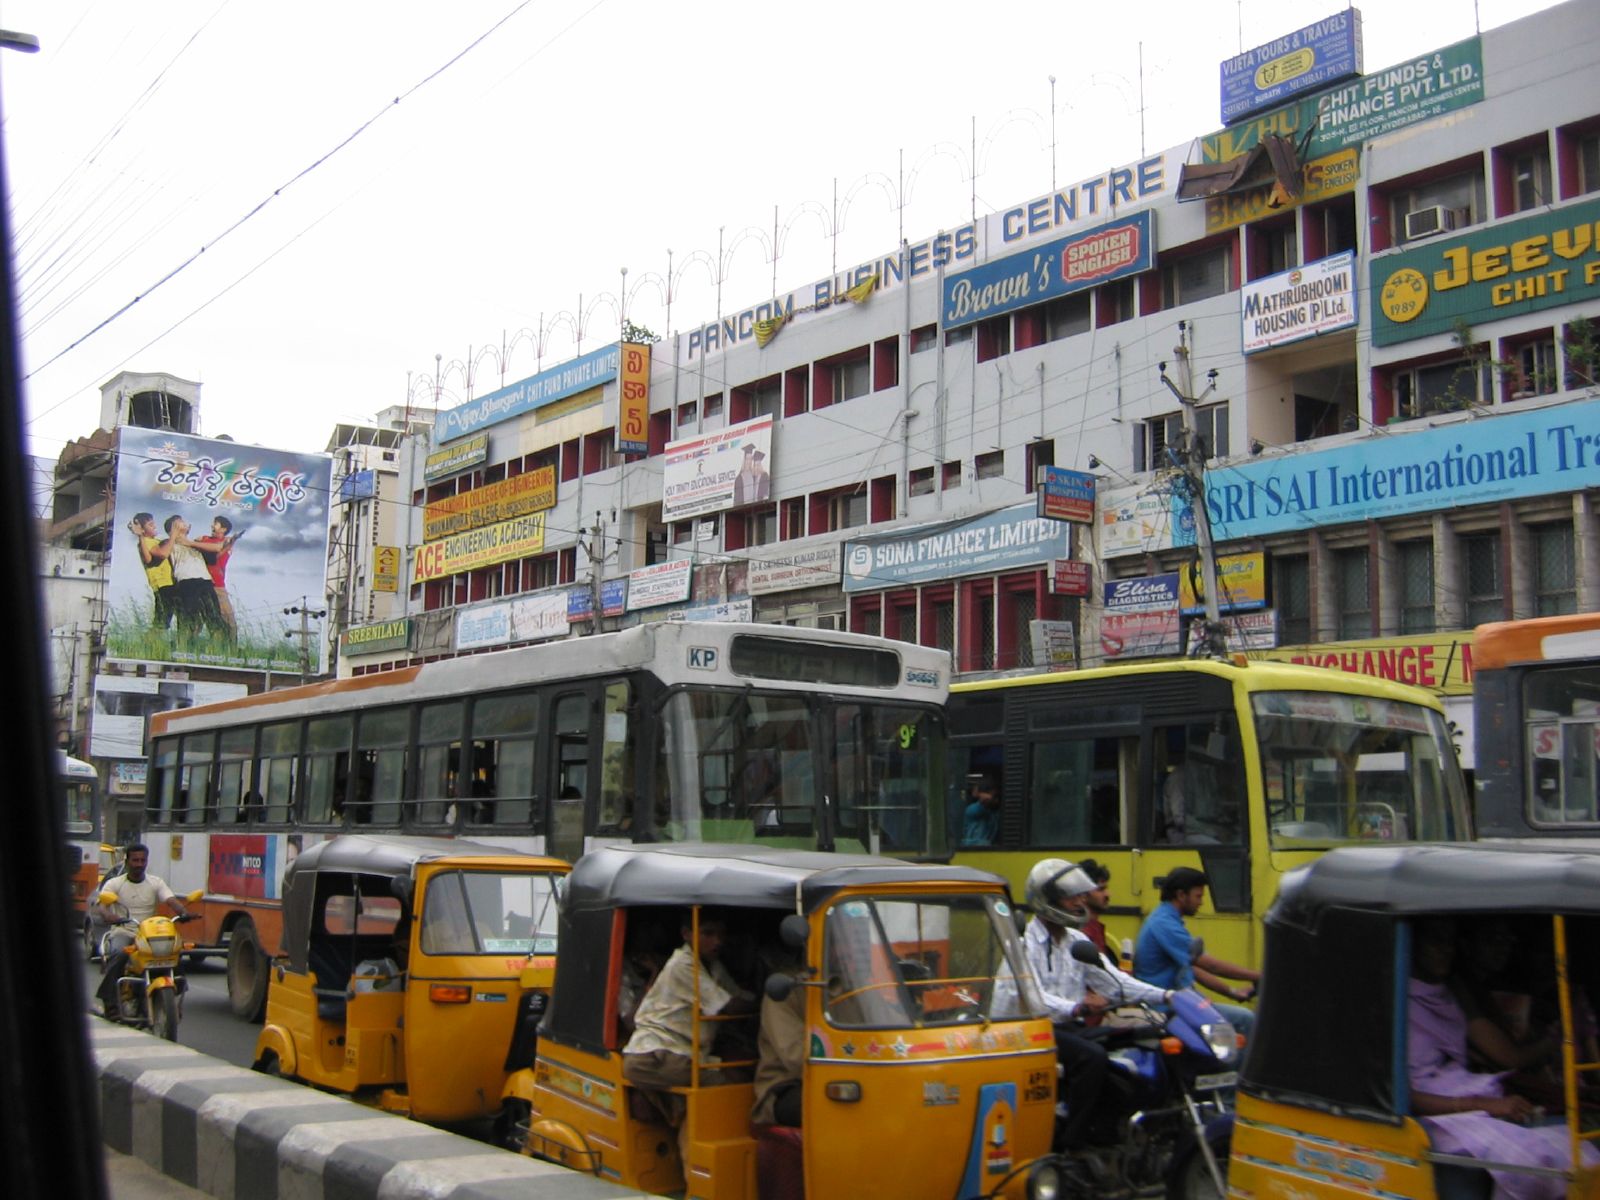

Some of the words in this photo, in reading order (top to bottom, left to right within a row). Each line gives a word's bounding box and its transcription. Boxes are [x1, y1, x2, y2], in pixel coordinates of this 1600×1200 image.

[1256, 39, 1290, 62] TOURS
[1303, 15, 1347, 42] TRAVELS
[1318, 84, 1361, 113] CHIT
[1363, 59, 1428, 97] FUNDS
[1431, 53, 1443, 72] &
[1318, 91, 1396, 132] FINANCE
[1399, 75, 1436, 104] PVT.
[1437, 62, 1479, 91] LTD.
[1324, 158, 1355, 177] SPOKEN
[688, 293, 794, 361] PANCOM
[1002, 161, 1165, 243] CENTRE
[1067, 231, 1131, 261] SPOKEN
[1067, 249, 1131, 281] ENGLISH
[948, 253, 1051, 322] Brown's
[1244, 271, 1348, 321] MATHRUBHOOMI
[1491, 269, 1568, 308] CHIT
[1255, 306, 1306, 338] HOUSING
[1390, 300, 1417, 317] 1989
[470, 479, 498, 507] COLLEGE
[510, 469, 553, 498] ENGINEERING
[1206, 479, 1257, 525] SRI
[1263, 467, 1319, 518] SAI
[1328, 432, 1538, 508] International
[415, 543, 444, 581] ACE
[444, 529, 498, 560] ENGINEERING
[499, 514, 542, 546] ACADEMY
[875, 541, 917, 569] SONA
[917, 528, 988, 563] FINANCE
[988, 515, 1061, 551] LIMITED
[378, 548, 395, 576] ACE
[1108, 591, 1174, 606] DIAGNOSTICS
[347, 621, 405, 645] SREENILAYA
[689, 648, 716, 668] KP
